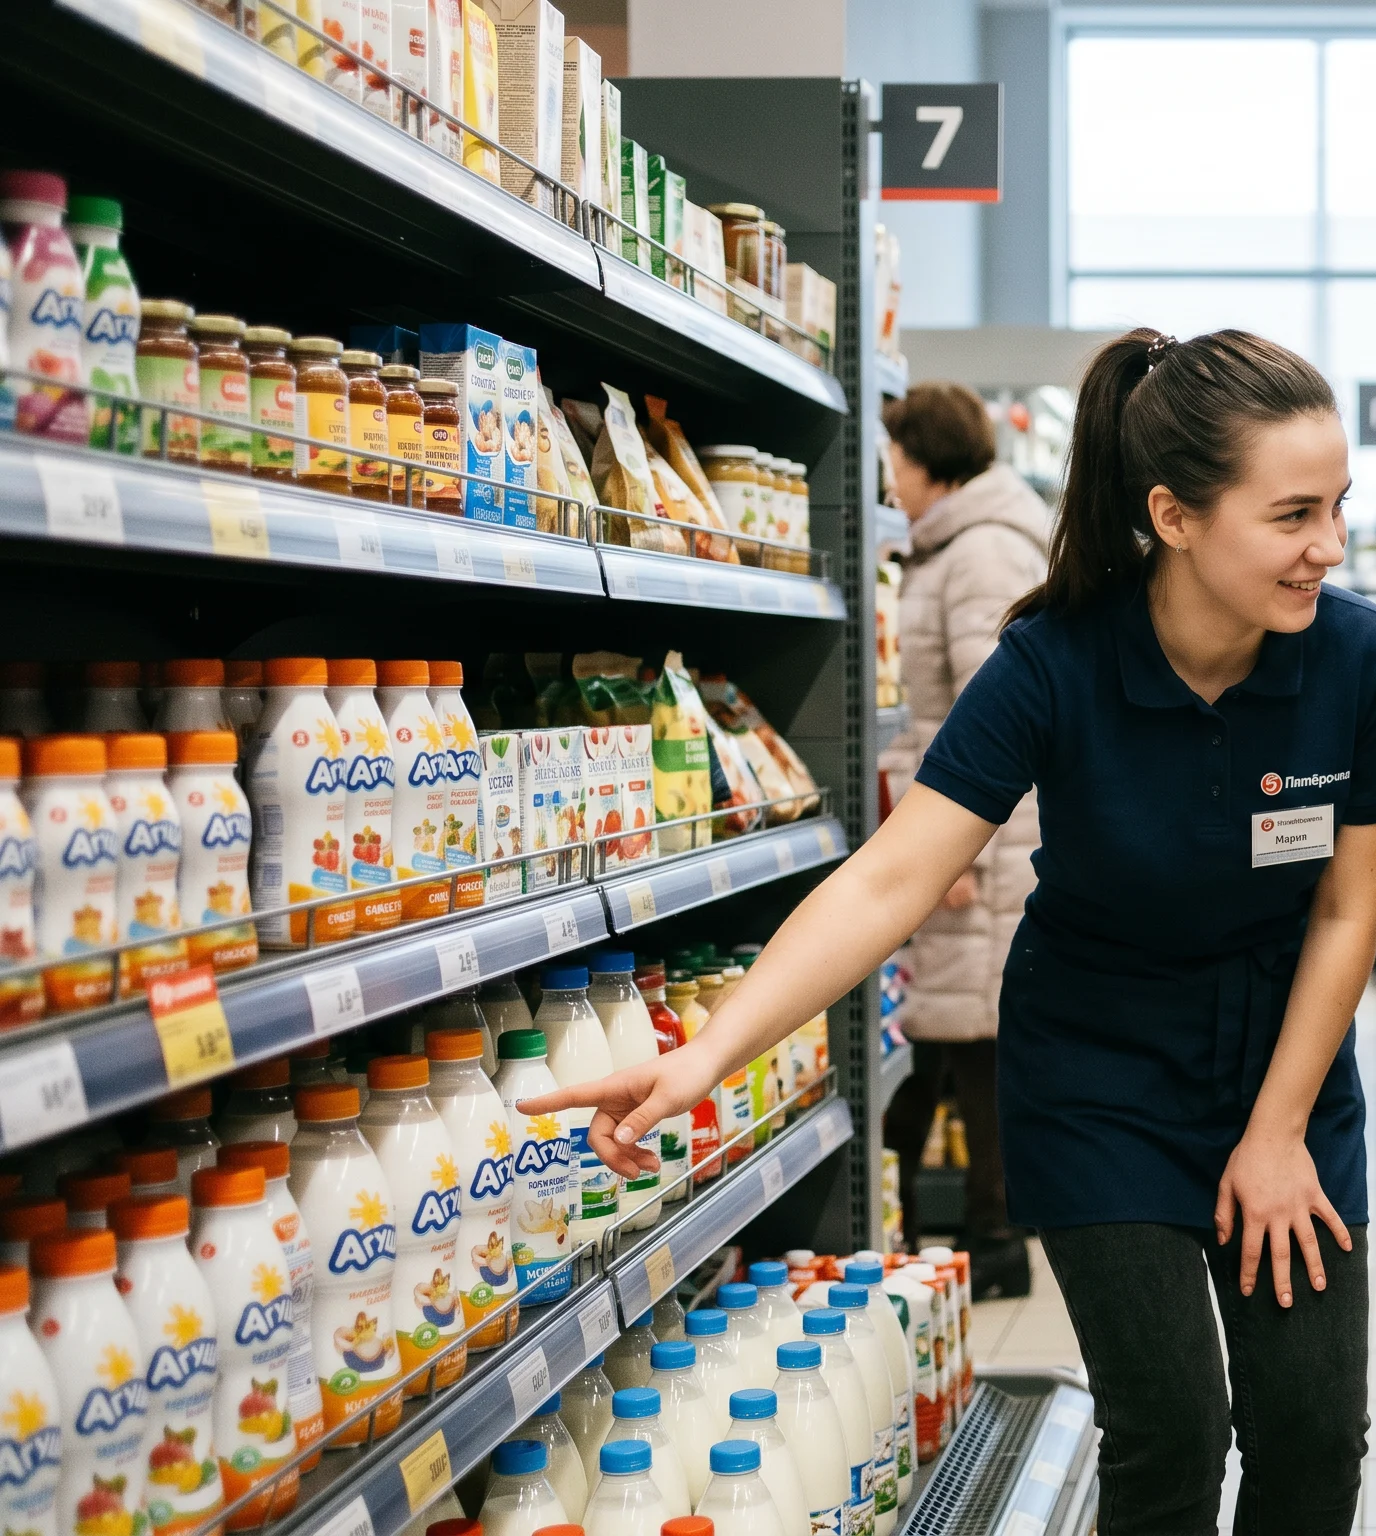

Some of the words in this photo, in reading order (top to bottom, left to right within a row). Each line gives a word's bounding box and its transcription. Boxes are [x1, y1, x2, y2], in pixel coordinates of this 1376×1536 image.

[916, 106, 963, 169] 7
[1275, 834, 1307, 845] Мария
[514, 1137, 570, 1175] Агуш
